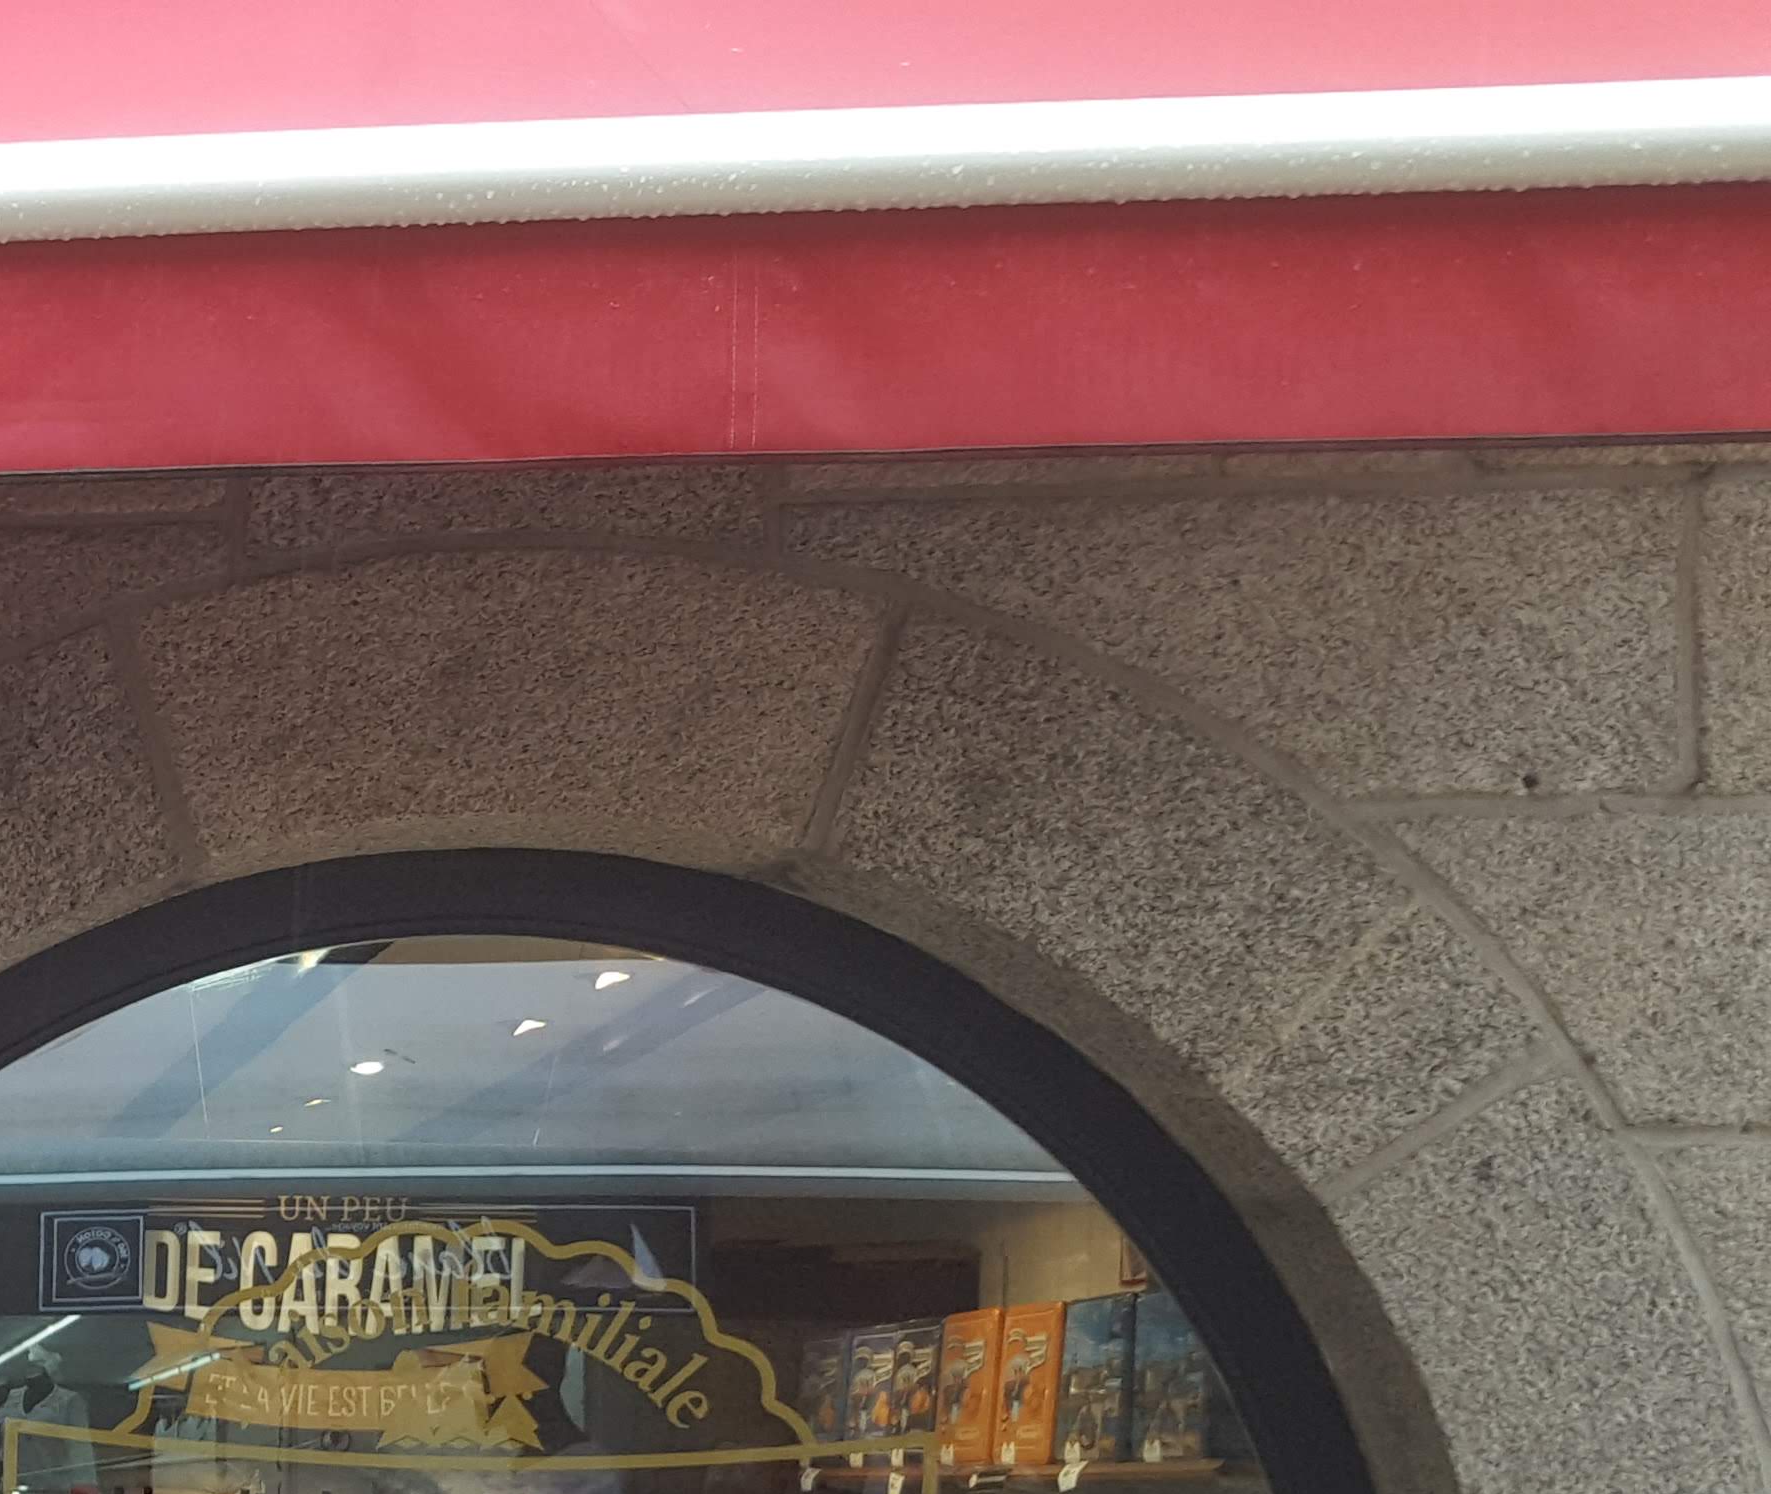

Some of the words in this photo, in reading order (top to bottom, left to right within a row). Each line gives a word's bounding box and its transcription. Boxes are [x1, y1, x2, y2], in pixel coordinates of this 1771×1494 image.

[278, 1195, 328, 1222] UN
[339, 1196, 411, 1222] PEU
[141, 1229, 224, 1320] DE
[239, 1231, 542, 1336] CARAMEL
[280, 1384, 319, 1416] VIE
[327, 1386, 372, 1418] EST
